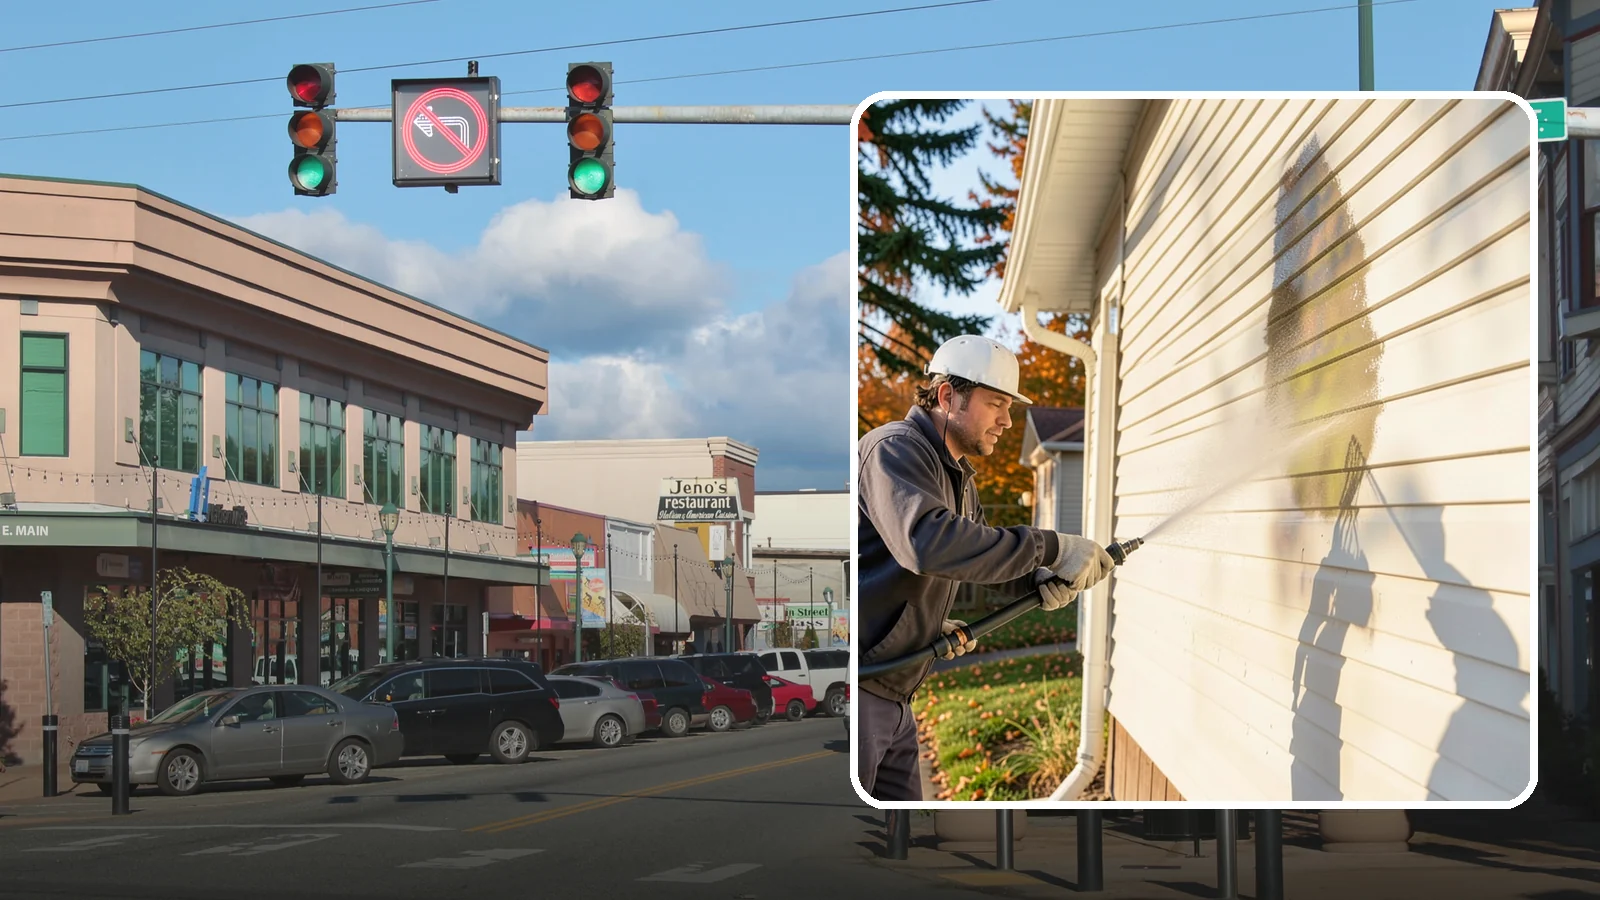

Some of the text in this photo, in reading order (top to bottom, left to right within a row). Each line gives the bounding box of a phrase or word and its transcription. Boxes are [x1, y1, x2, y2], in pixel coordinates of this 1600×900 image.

[670, 480, 727, 494] Jeno's
[665, 496, 731, 509] restaurant
[686, 509, 714, 519] American
[715, 509, 738, 519] Cuisine
[2, 525, 49, 536] E. MAIN
[797, 607, 828, 617] Street
